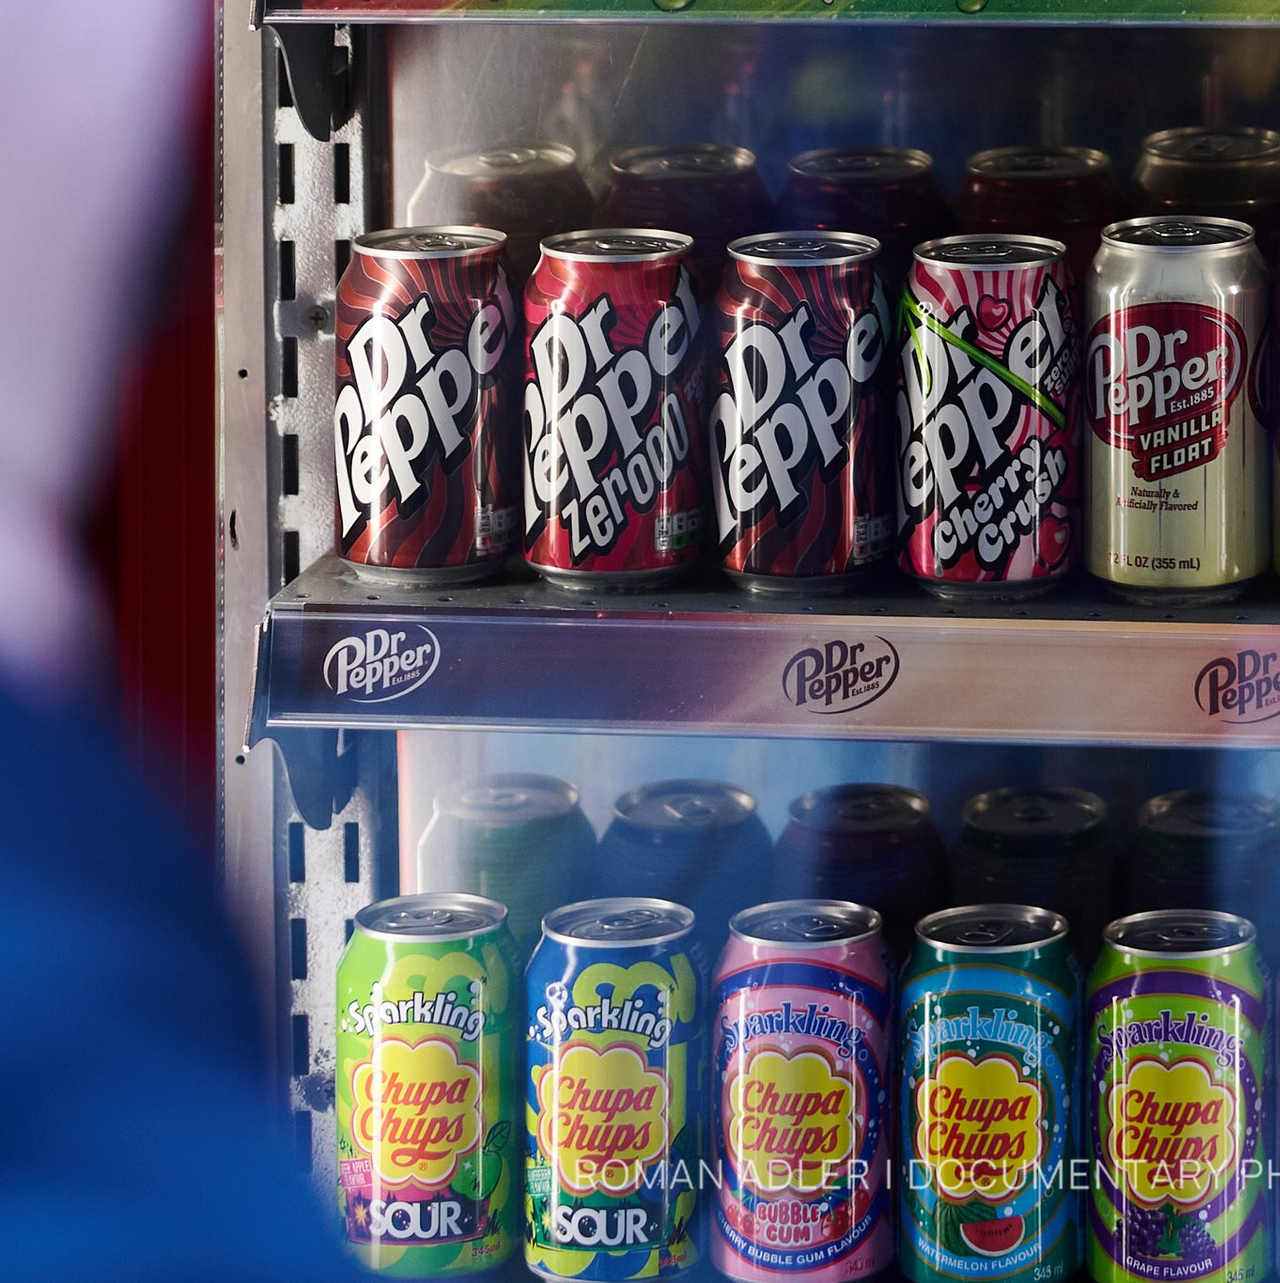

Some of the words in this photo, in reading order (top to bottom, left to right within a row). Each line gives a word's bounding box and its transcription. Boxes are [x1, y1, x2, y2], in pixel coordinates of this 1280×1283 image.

[1139, 407, 1225, 450] VANILLA
[1150, 437, 1213, 473] FLOAT
[1131, 486, 1171, 500] Naturally
[1173, 489, 1180, 498] &
[366, 629, 406, 663] Dr
[824, 640, 866, 673] Dr
[784, 649, 890, 706] Pepper
[1238, 650, 1277, 683] Dr
[1097, 1009, 1242, 1069] Sparkling
[743, 1079, 845, 1125] Chupa
[928, 1085, 1032, 1132] Chupa
[1120, 1090, 1223, 1136] Chupa
[369, 1201, 461, 1239] SOUR
[555, 1207, 648, 1246] SOUR
[757, 1201, 821, 1225] BUBBLE
[718, 1211, 747, 1250] CHERRY
[748, 1245, 793, 1264] BUBBLE
[796, 1250, 825, 1264] GUM
[827, 1215, 872, 1256] FLAVOUR
[766, 1225, 812, 1245] GUM
[1126, 1256, 1159, 1276] GRAPE
[1163, 1258, 1212, 1277] FLAVOUR
